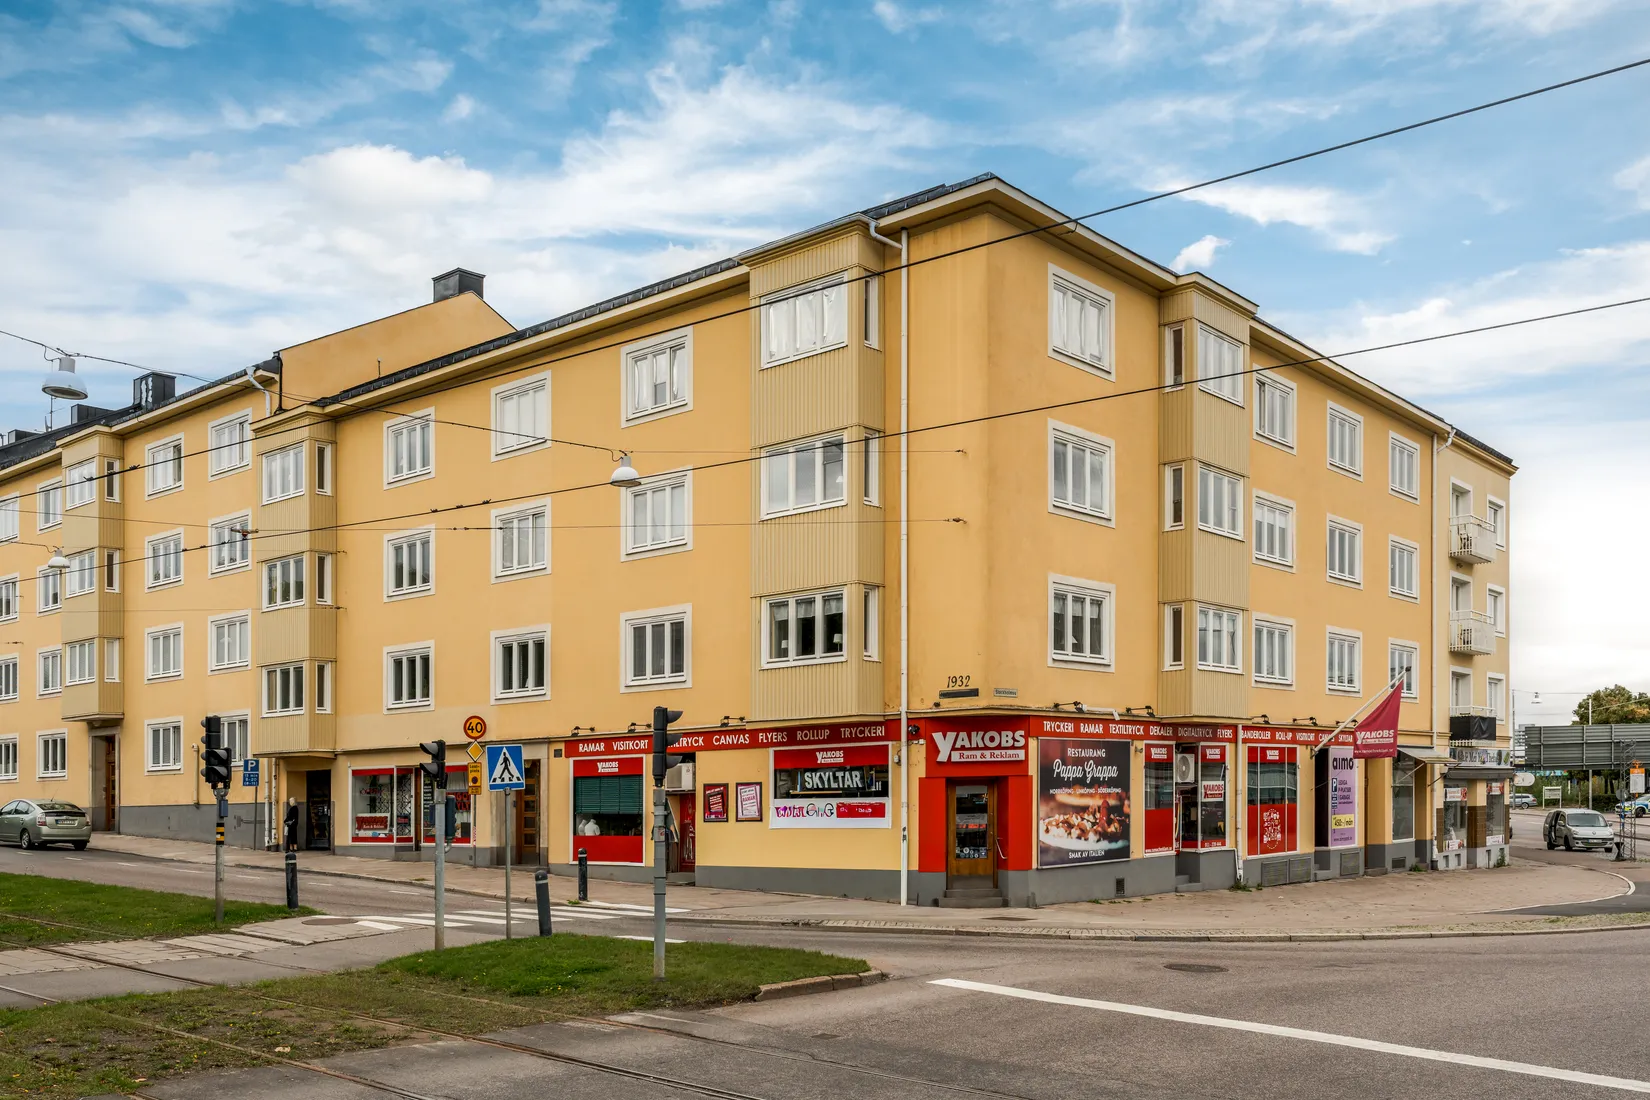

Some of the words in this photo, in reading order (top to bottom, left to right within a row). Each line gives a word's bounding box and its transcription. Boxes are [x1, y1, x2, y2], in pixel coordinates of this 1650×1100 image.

[947, 675, 971, 688] 1932
[467, 722, 483, 734] 40
[1043, 720, 1074, 733] TRYCKERI
[1080, 723, 1104, 734] RAMAR
[1109, 724, 1144, 736] TEXTILTRYCK
[1149, 725, 1173, 736] DEKALER
[1178, 726, 1213, 738] DIGITALTRYCK
[1217, 728, 1232, 738] FLYERS
[578, 742, 605, 752] RAMAR
[612, 740, 648, 751] VISITKORT
[712, 734, 750, 746] CANVAS
[758, 731, 788, 743] FLYERS
[796, 729, 830, 741] ROLLUP
[840, 726, 885, 738] TRYCKERI
[1276, 732, 1292, 740] ROLL-UP
[1356, 730, 1394, 744] YAKOBS
[932, 730, 1026, 762] YAKOBS
[816, 750, 844, 764] YAKOBS
[990, 751, 1020, 759] Reklam
[1068, 748, 1106, 758] RESTAURANG
[248, 760, 256, 772] P
[1332, 757, 1354, 770] aimo
[1053, 758, 1084, 781] Pappa
[1084, 760, 1118, 784] Grappa
[804, 770, 862, 789] SKYLTAR
